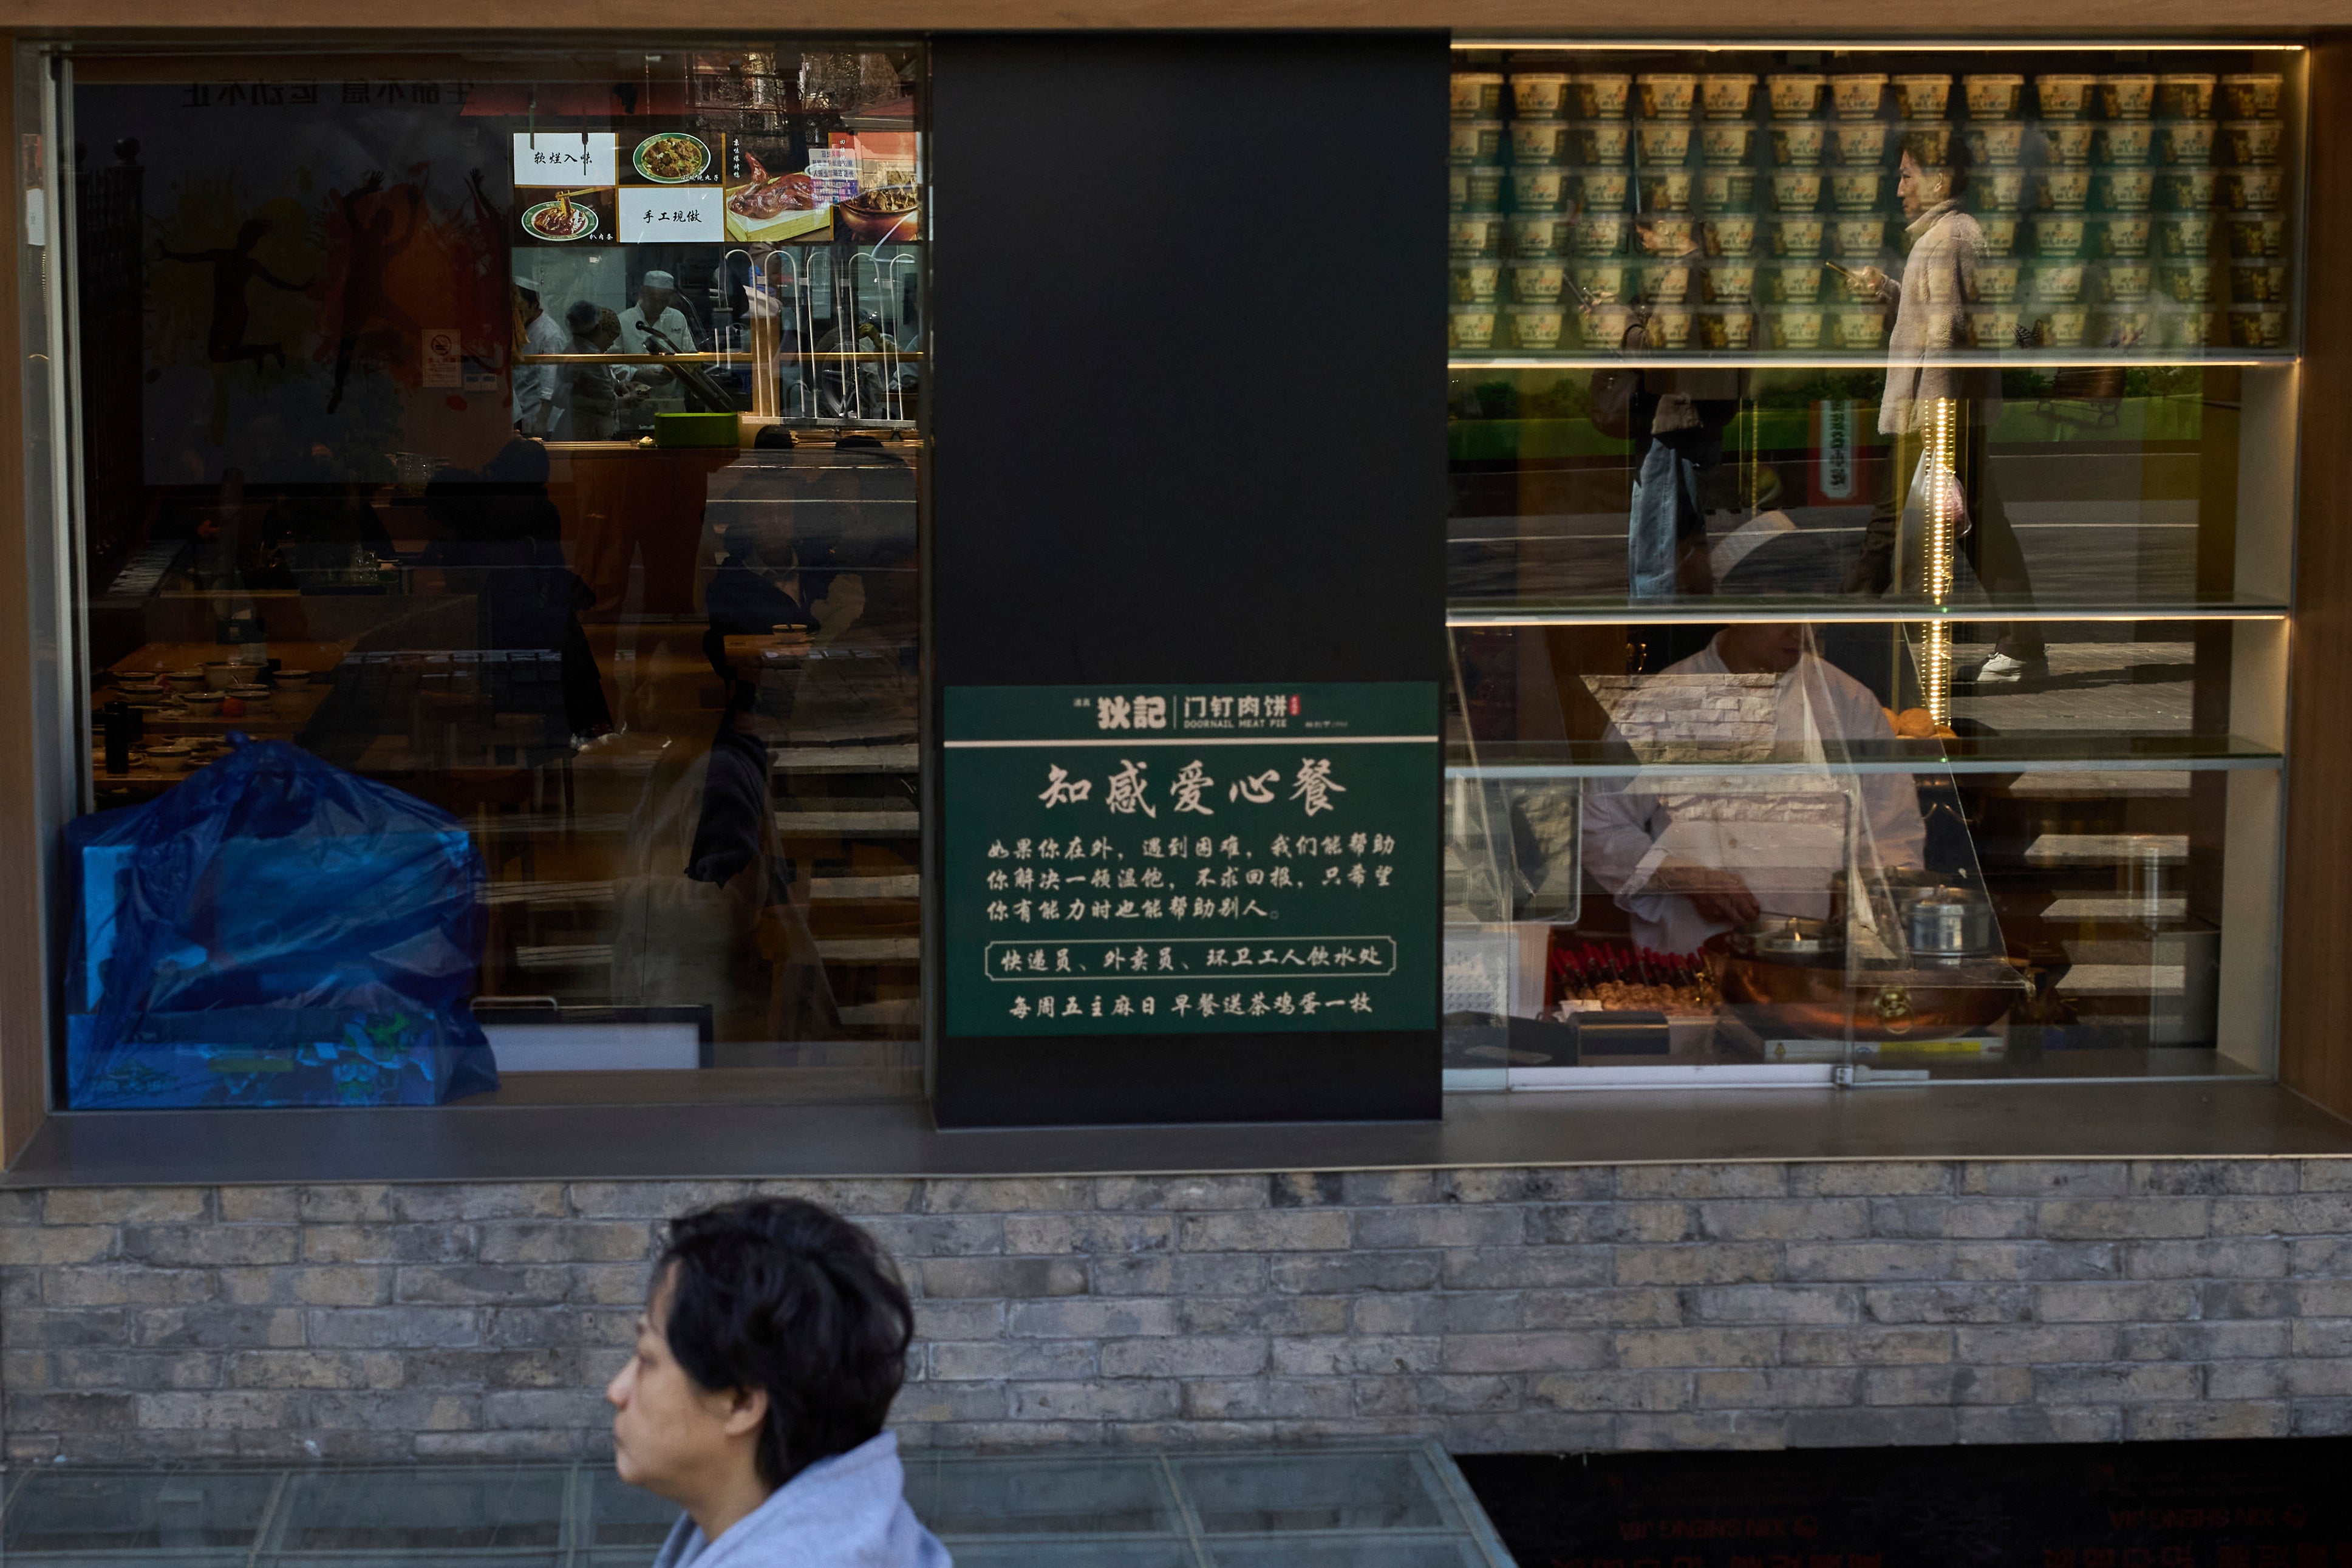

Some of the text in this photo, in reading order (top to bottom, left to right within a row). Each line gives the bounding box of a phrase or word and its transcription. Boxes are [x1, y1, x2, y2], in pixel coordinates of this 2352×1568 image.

[643, 210, 702, 223] 手工现做
[1184, 695, 1287, 718] 门钉肉饼
[1184, 718, 1287, 729] DOORNAIL MEAT PIE
[1038, 758, 1346, 819] 知感爱心餐
[987, 895, 1279, 924] 你有能力时也能帮助别人。
[1001, 945, 1383, 973] 快递员、外卖员、环卫工人饮水处
[1009, 991, 1372, 1019] 每周五主麻日 早餐送茶鸡蛋一枚
